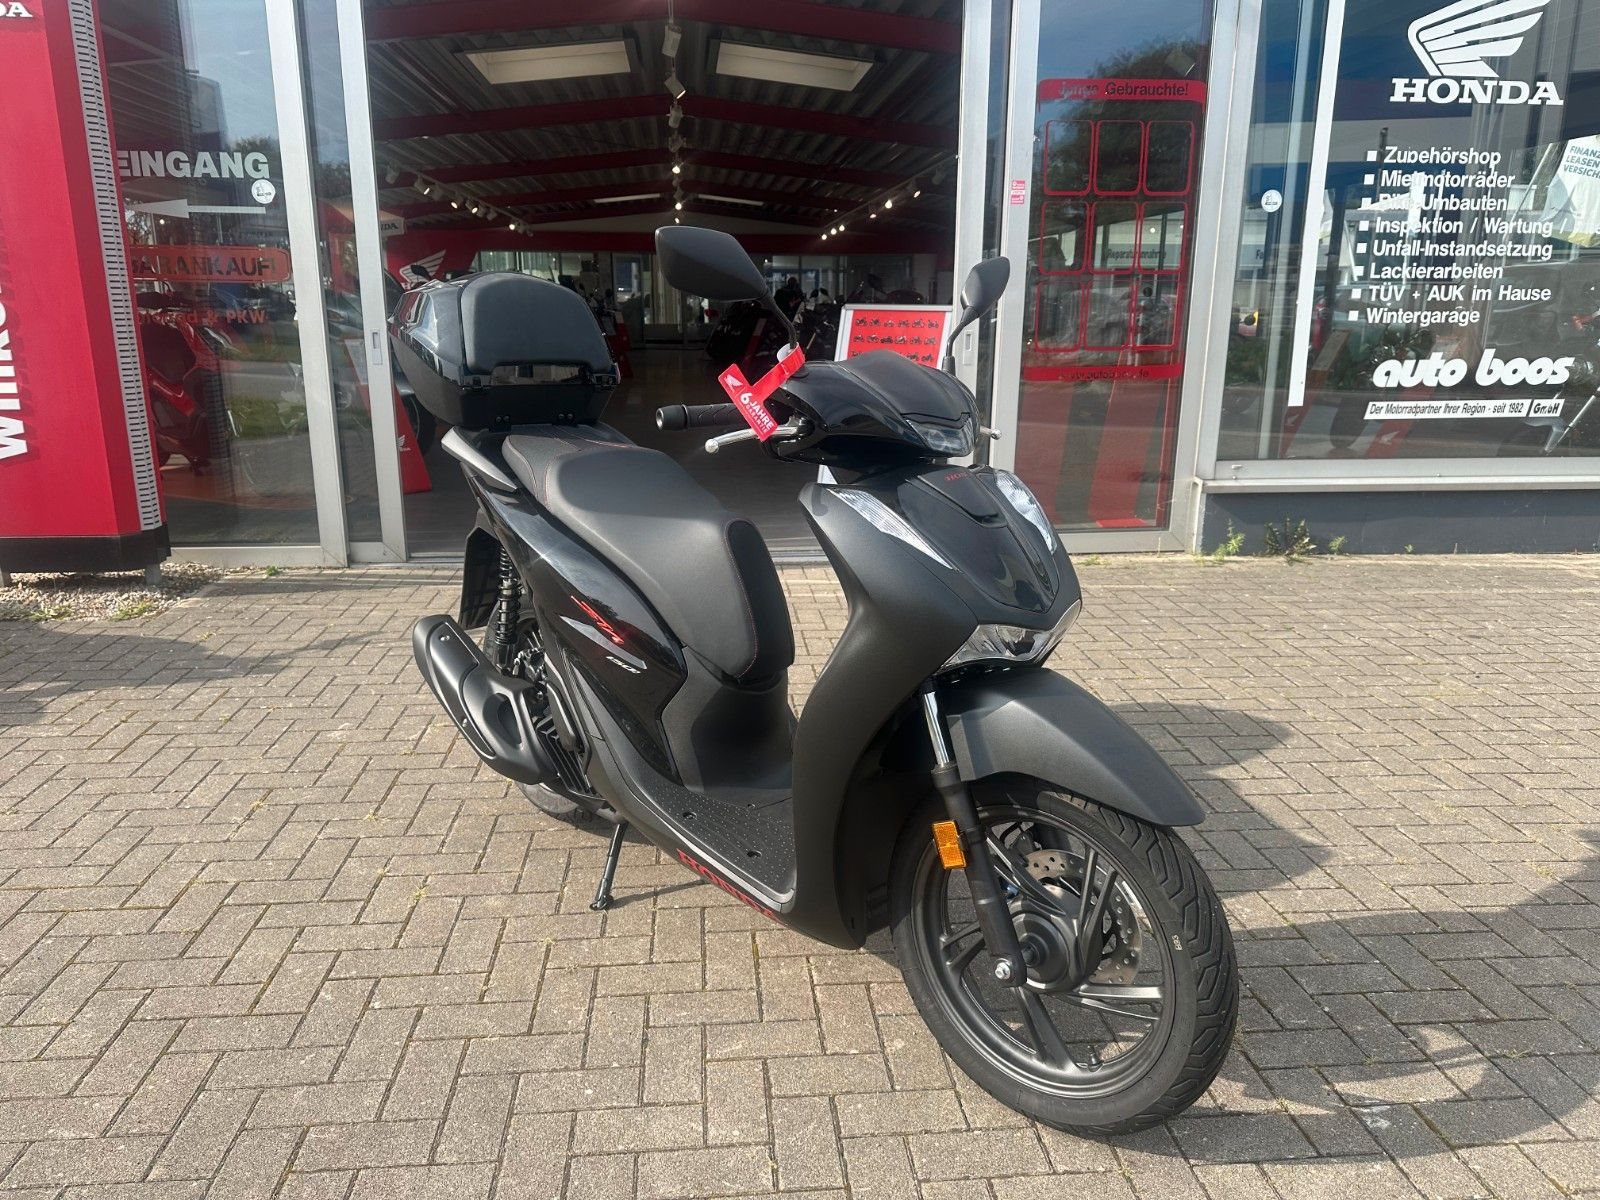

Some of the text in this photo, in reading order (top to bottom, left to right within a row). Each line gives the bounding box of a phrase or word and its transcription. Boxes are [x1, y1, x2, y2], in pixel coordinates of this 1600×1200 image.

[1105, 81, 1189, 96] Gebrauchte!
[1390, 78, 1564, 106] HONDA
[1384, 146, 1501, 168] Zubehörshop
[1376, 217, 1463, 236] Inspektion
[1485, 219, 1553, 237] Wartung
[1373, 240, 1553, 260] Unfall-Instandsetzung
[1370, 262, 1503, 279] Lackierarbeiten
[1369, 282, 1406, 300] TÜV
[1427, 285, 1465, 301] AUK
[1472, 284, 1491, 300] im
[1499, 285, 1551, 301] Hause
[1366, 307, 1480, 326] Wintergarage
[1372, 348, 1575, 387] auto boos
[740, 392, 774, 430] 6 JAHRE
[1369, 403, 1384, 414] Der
[1384, 403, 1442, 416] Motorradpartner
[1443, 402, 1460, 414] Ihrer
[1461, 402, 1486, 416] Region
[1492, 402, 1506, 413] seit
[1508, 401, 1523, 413] 1982
